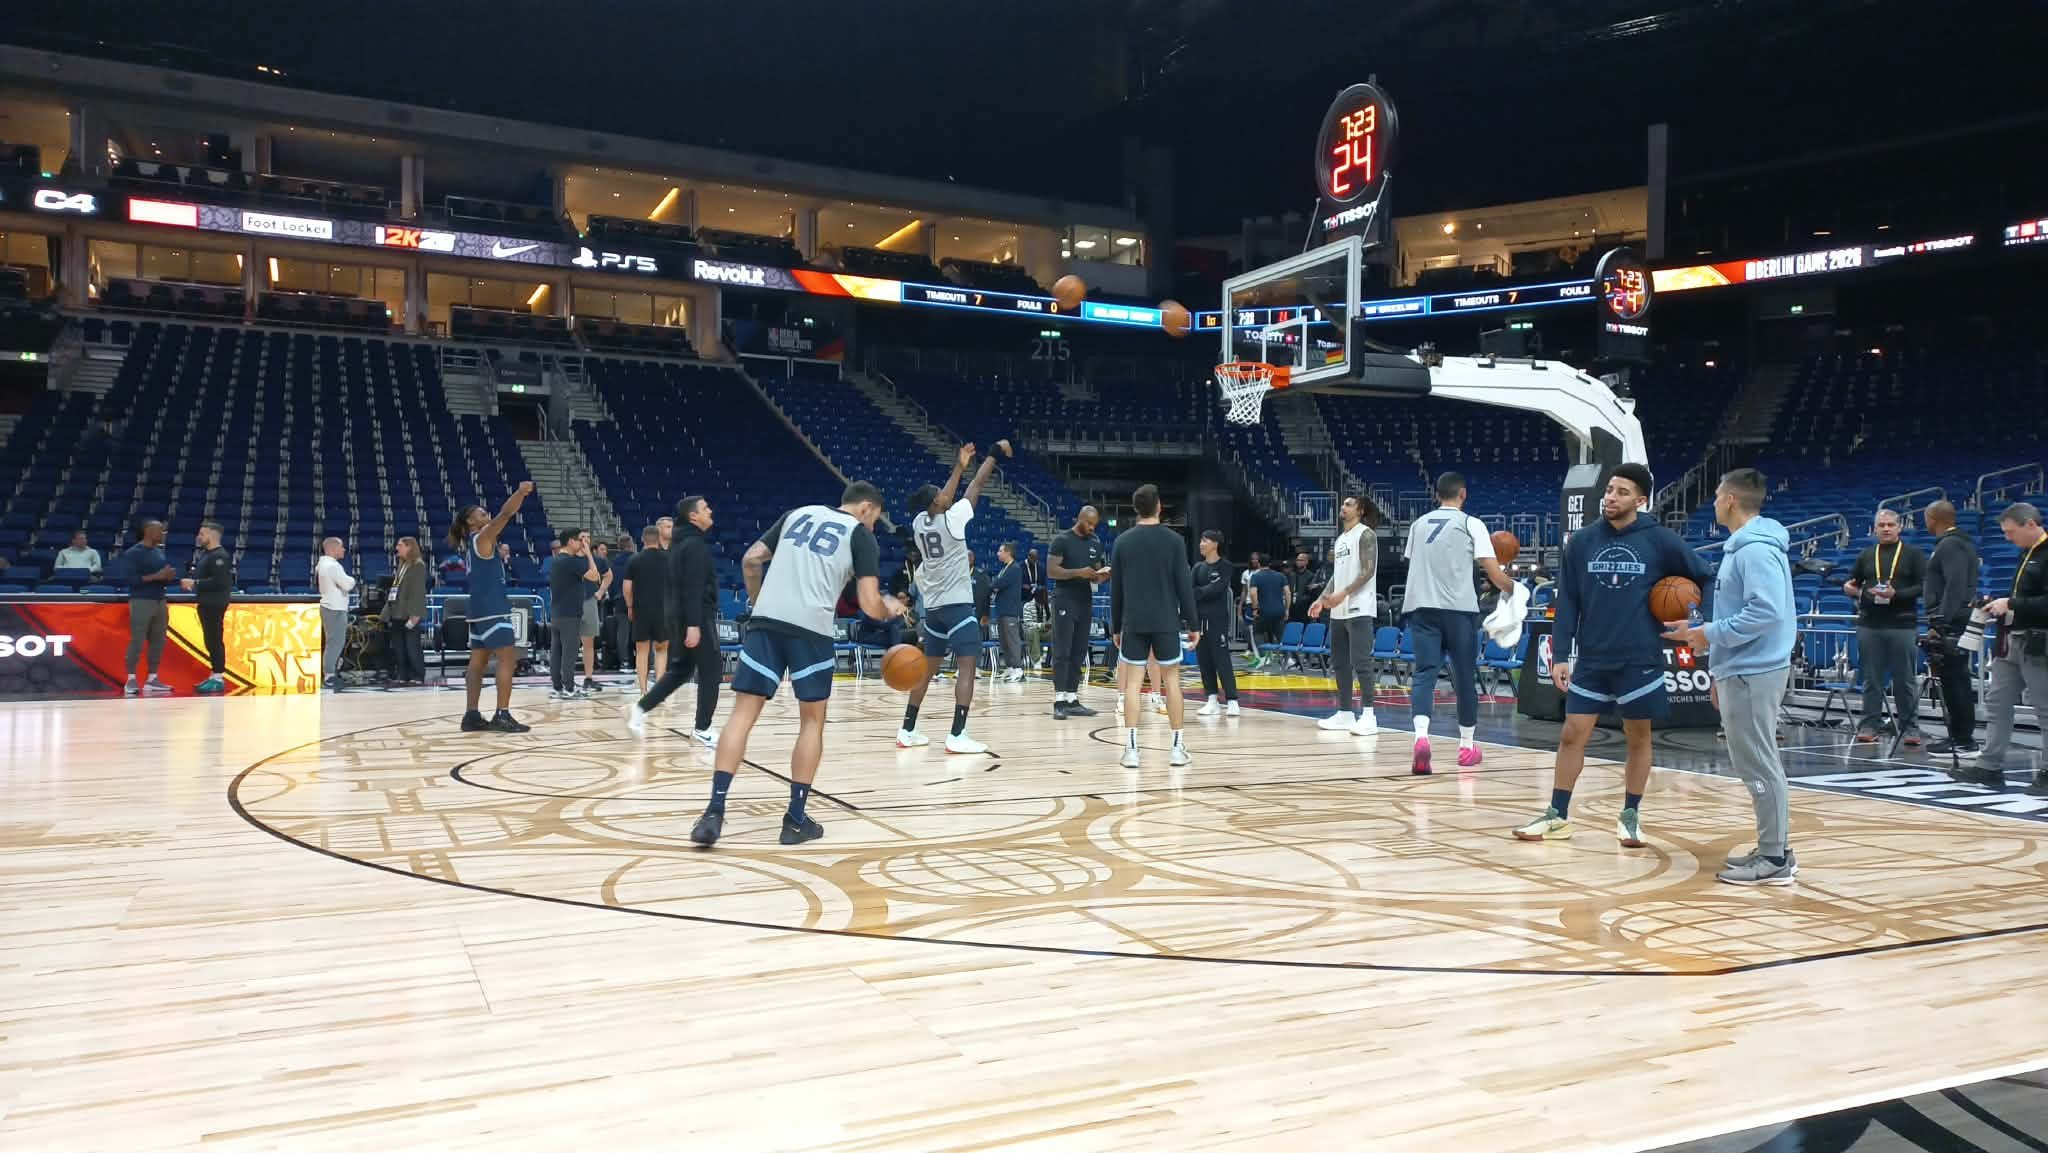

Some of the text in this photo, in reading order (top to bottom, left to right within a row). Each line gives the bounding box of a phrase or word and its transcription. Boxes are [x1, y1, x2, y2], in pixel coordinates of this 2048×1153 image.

[1340, 104, 1375, 140] 7:23
[1333, 134, 1371, 193] 24
[34, 189, 96, 213] C4
[248, 216, 276, 230] Foot
[694, 259, 765, 285] Revolut
[1756, 254, 1795, 280] BERLIN
[1796, 251, 1828, 274] GAME
[974, 294, 982, 306] 7
[1050, 302, 1058, 313] 0
[1454, 294, 1499, 308] TIMEOUTS
[1508, 291, 1518, 303] 7
[1032, 338, 1071, 361] 215
[1568, 495, 1584, 512] GET
[1427, 518, 1451, 544] 7
[1568, 513, 1584, 531] THE
[784, 513, 848, 557] 46
[919, 531, 945, 559] 18
[1591, 562, 1641, 573] GRIZZLIES
[0, 634, 72, 657] SOT
[1663, 669, 1713, 692] SSO
